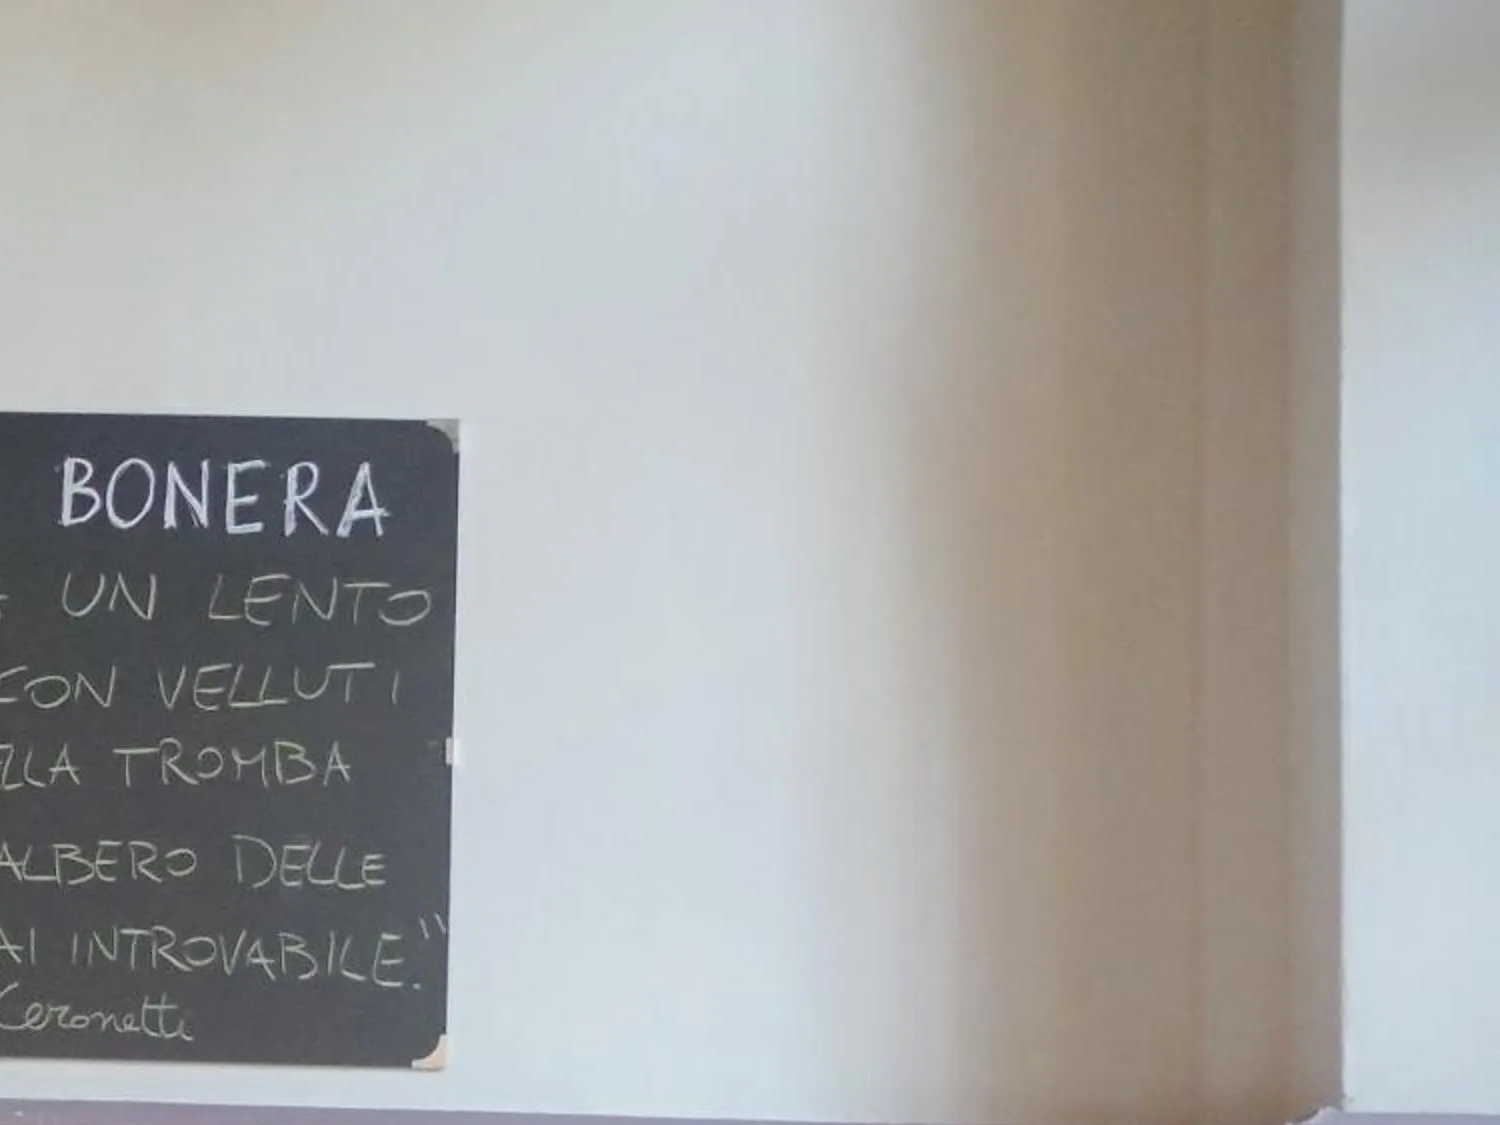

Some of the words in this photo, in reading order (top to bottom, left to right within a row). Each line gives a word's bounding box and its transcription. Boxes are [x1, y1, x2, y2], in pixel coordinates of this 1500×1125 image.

[60, 455, 391, 538] BONERA
[62, 573, 157, 621] UN
[208, 573, 433, 626] LENTO
[158, 661, 399, 712] VELLUTI
[113, 736, 351, 788] TROMBA
[233, 833, 386, 890] DELLE
